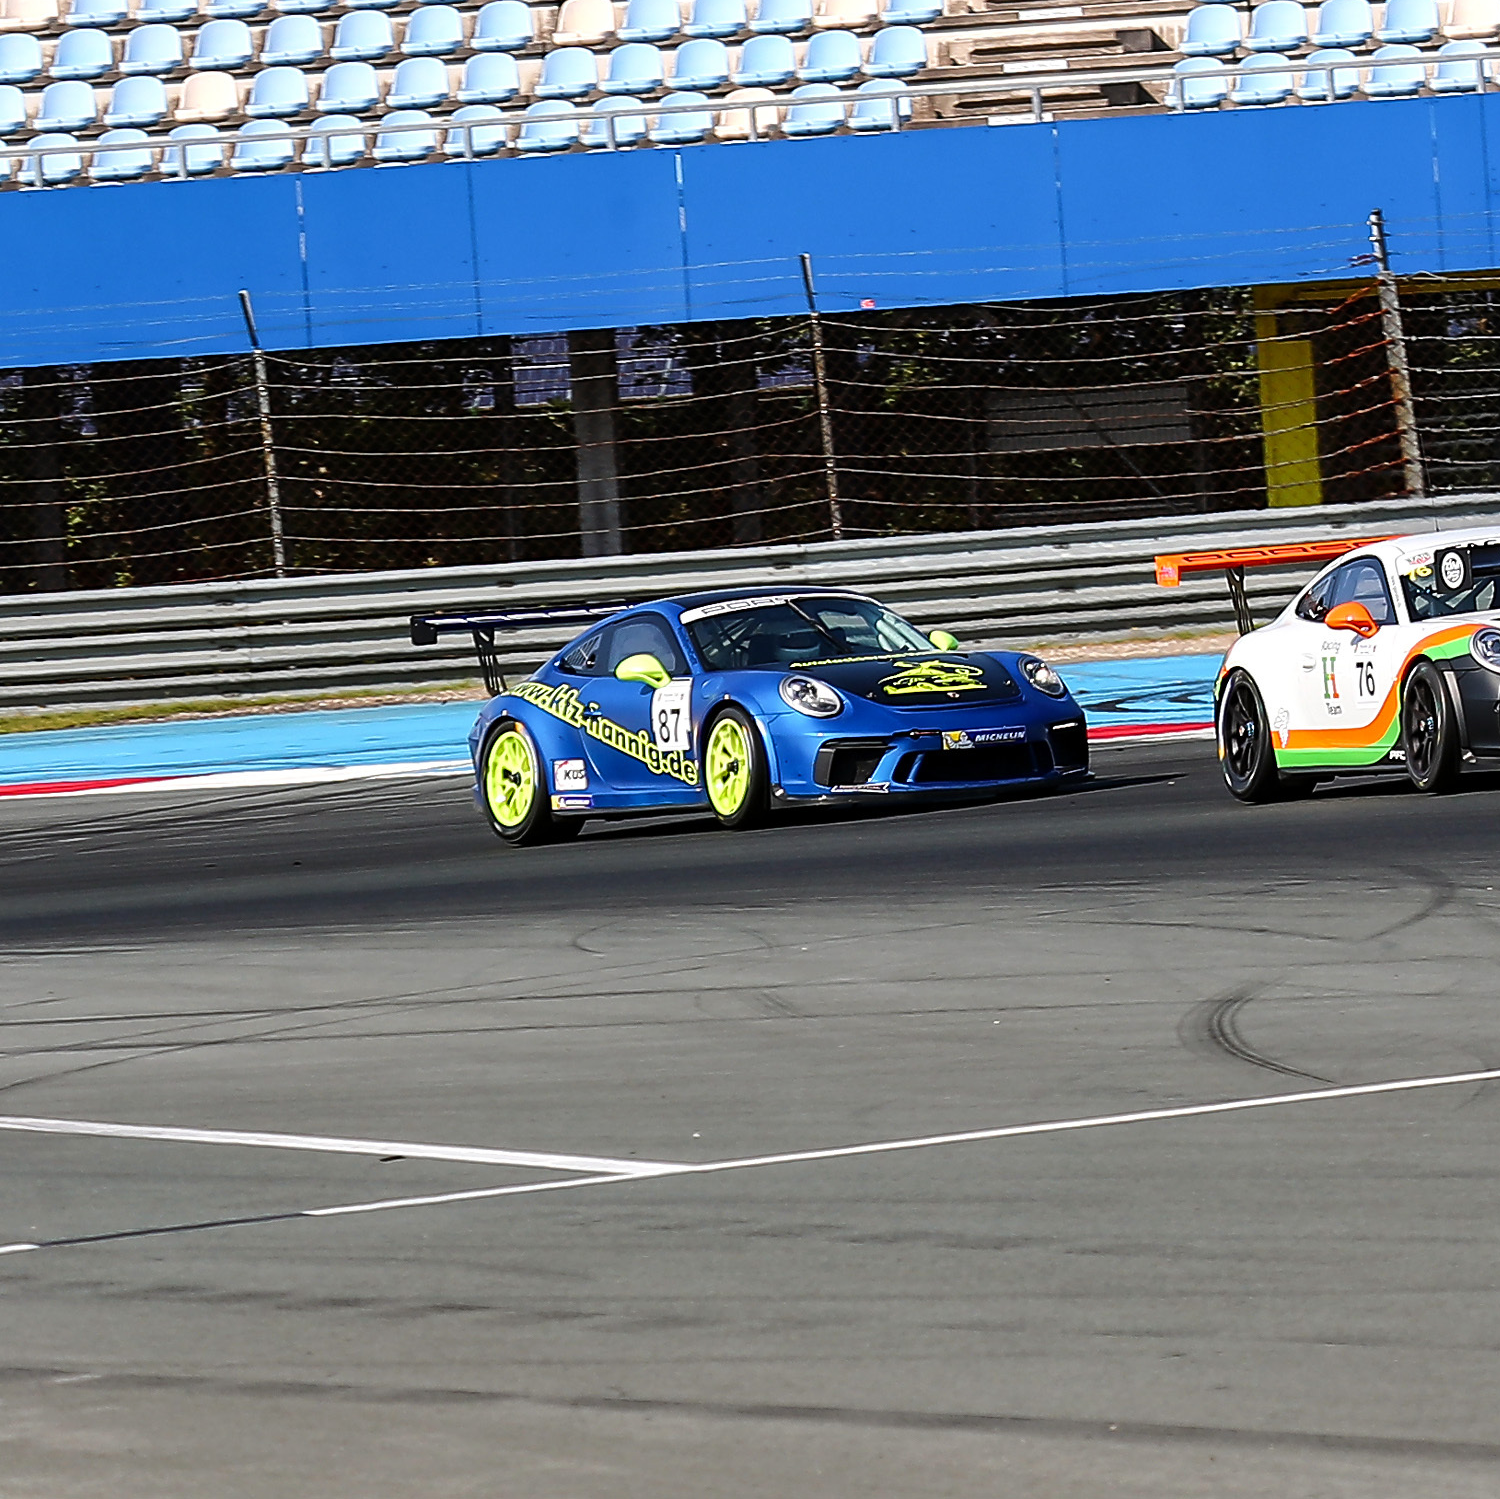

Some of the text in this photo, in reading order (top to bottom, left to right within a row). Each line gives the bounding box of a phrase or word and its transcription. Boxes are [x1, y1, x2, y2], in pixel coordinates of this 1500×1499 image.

[1355, 661, 1376, 697] 76
[656, 708, 682, 744] 87
[974, 731, 1027, 743] MICHELIN
